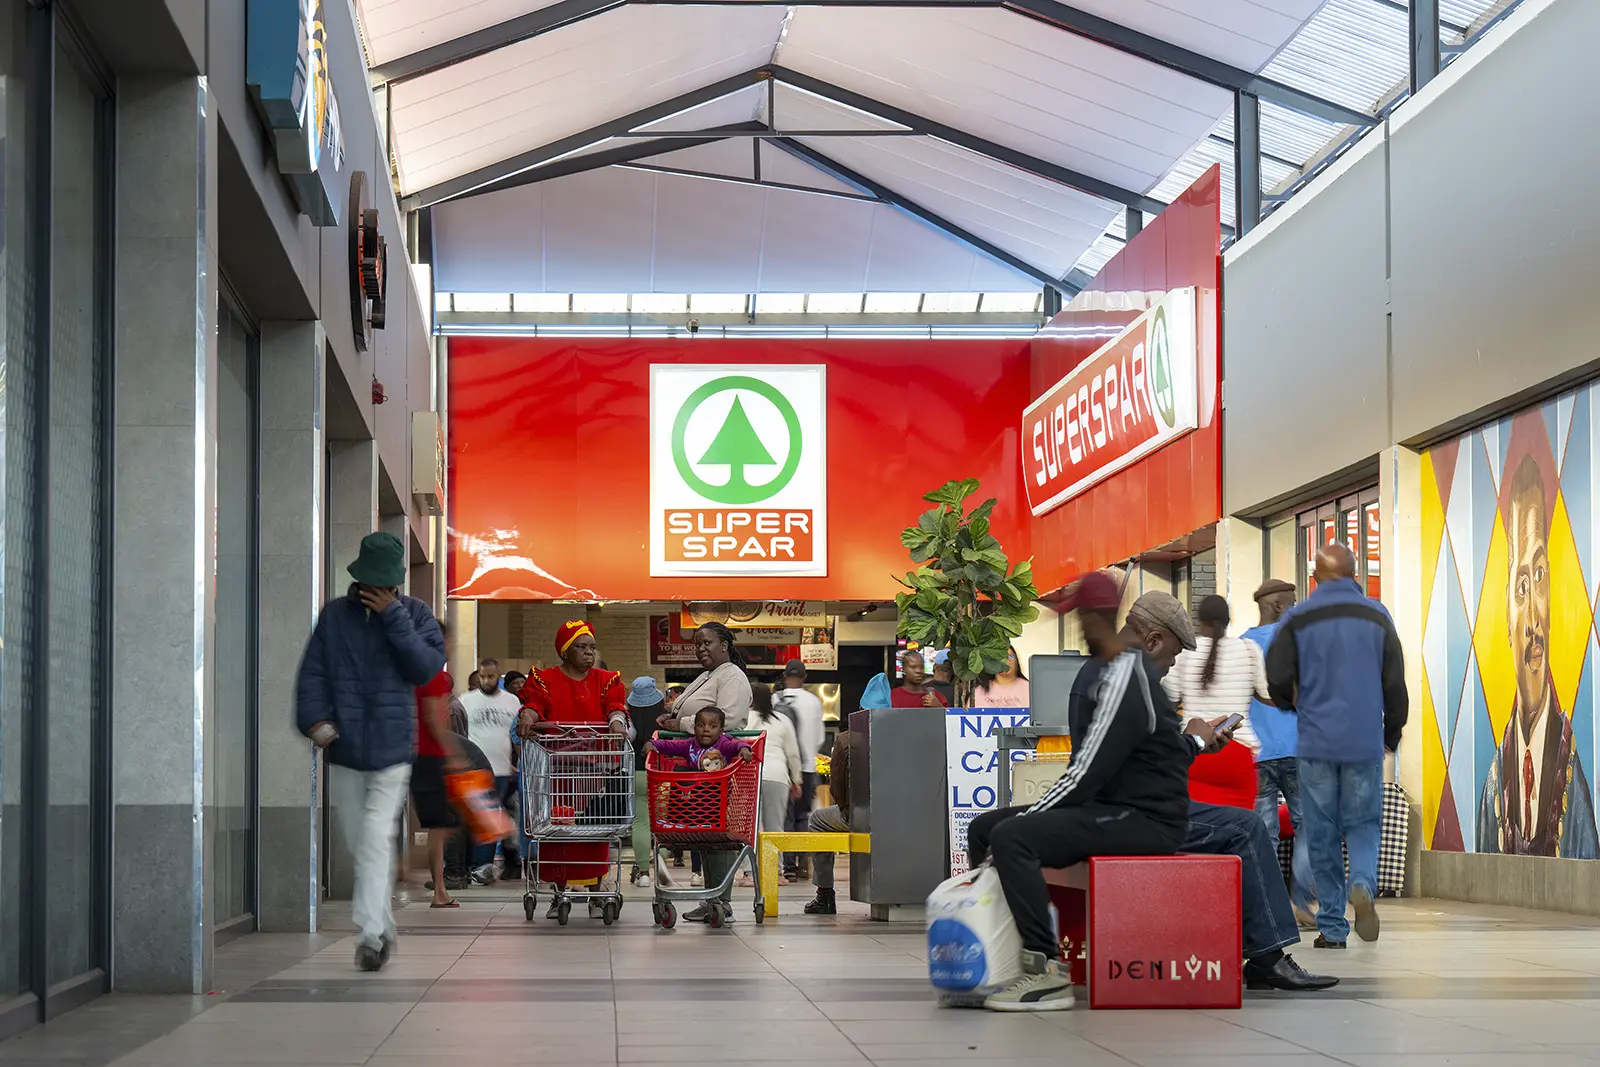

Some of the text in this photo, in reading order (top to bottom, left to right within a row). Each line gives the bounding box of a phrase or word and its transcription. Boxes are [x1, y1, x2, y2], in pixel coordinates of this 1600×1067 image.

[1033, 341, 1152, 487] SUPERSPAR
[668, 512, 810, 534] SUPER
[682, 536, 795, 558] SPAR
[764, 601, 806, 617] Fruit
[961, 750, 1037, 774] CAS
[1108, 954, 1221, 981] DENLYN
